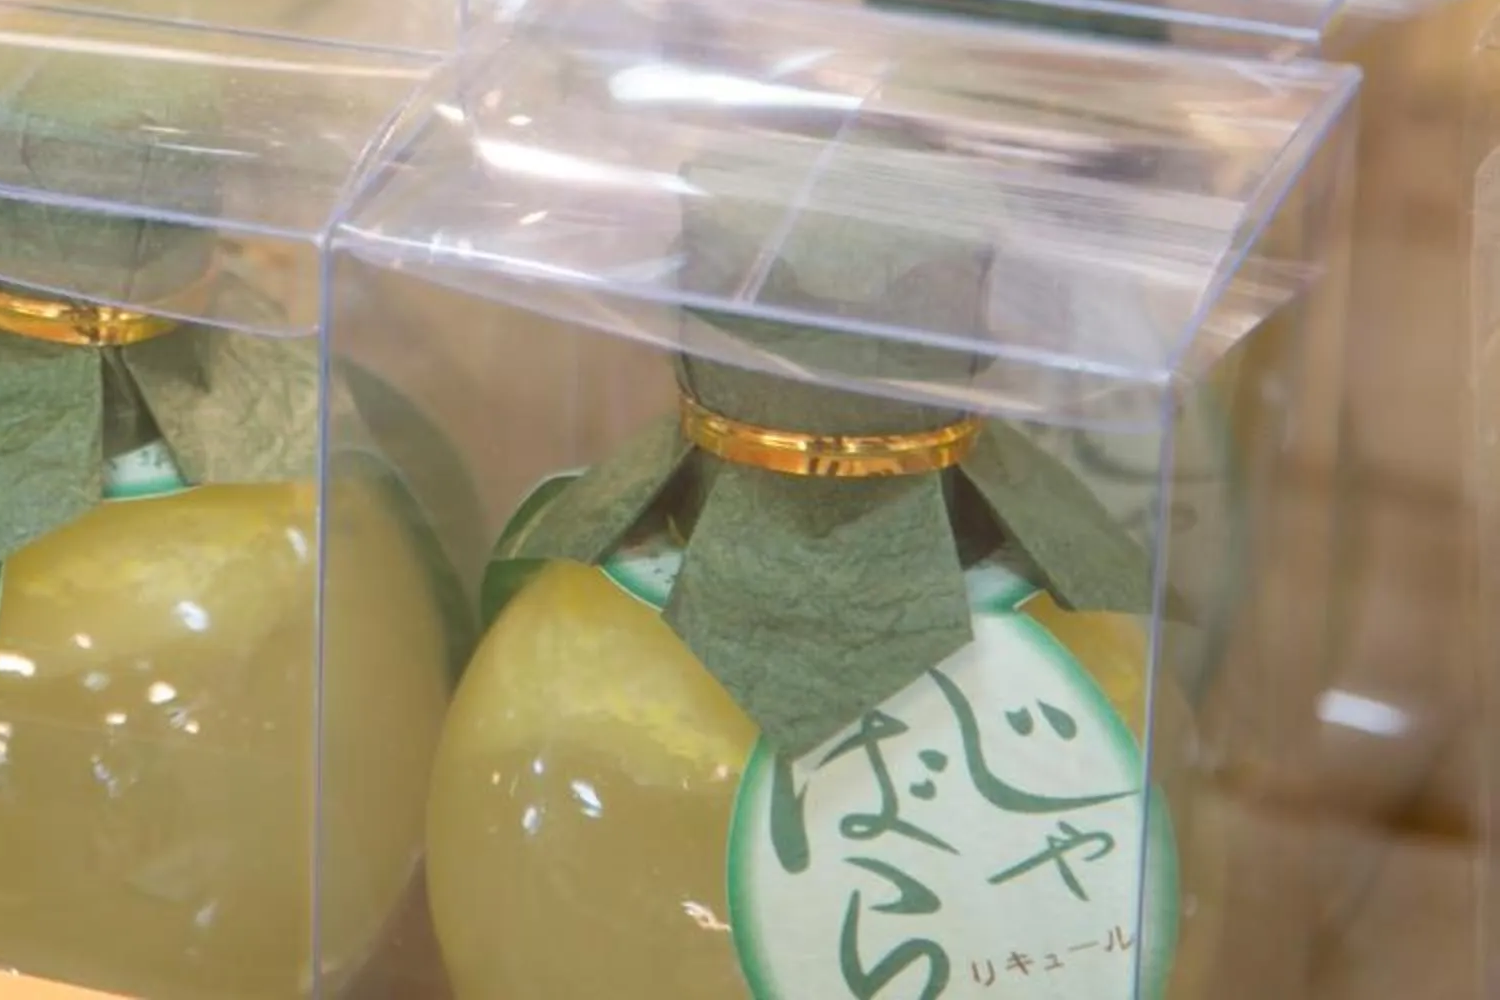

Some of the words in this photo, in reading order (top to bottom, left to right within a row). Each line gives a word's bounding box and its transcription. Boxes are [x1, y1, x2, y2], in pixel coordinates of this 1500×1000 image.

[970, 925, 1136, 987] リキュール
